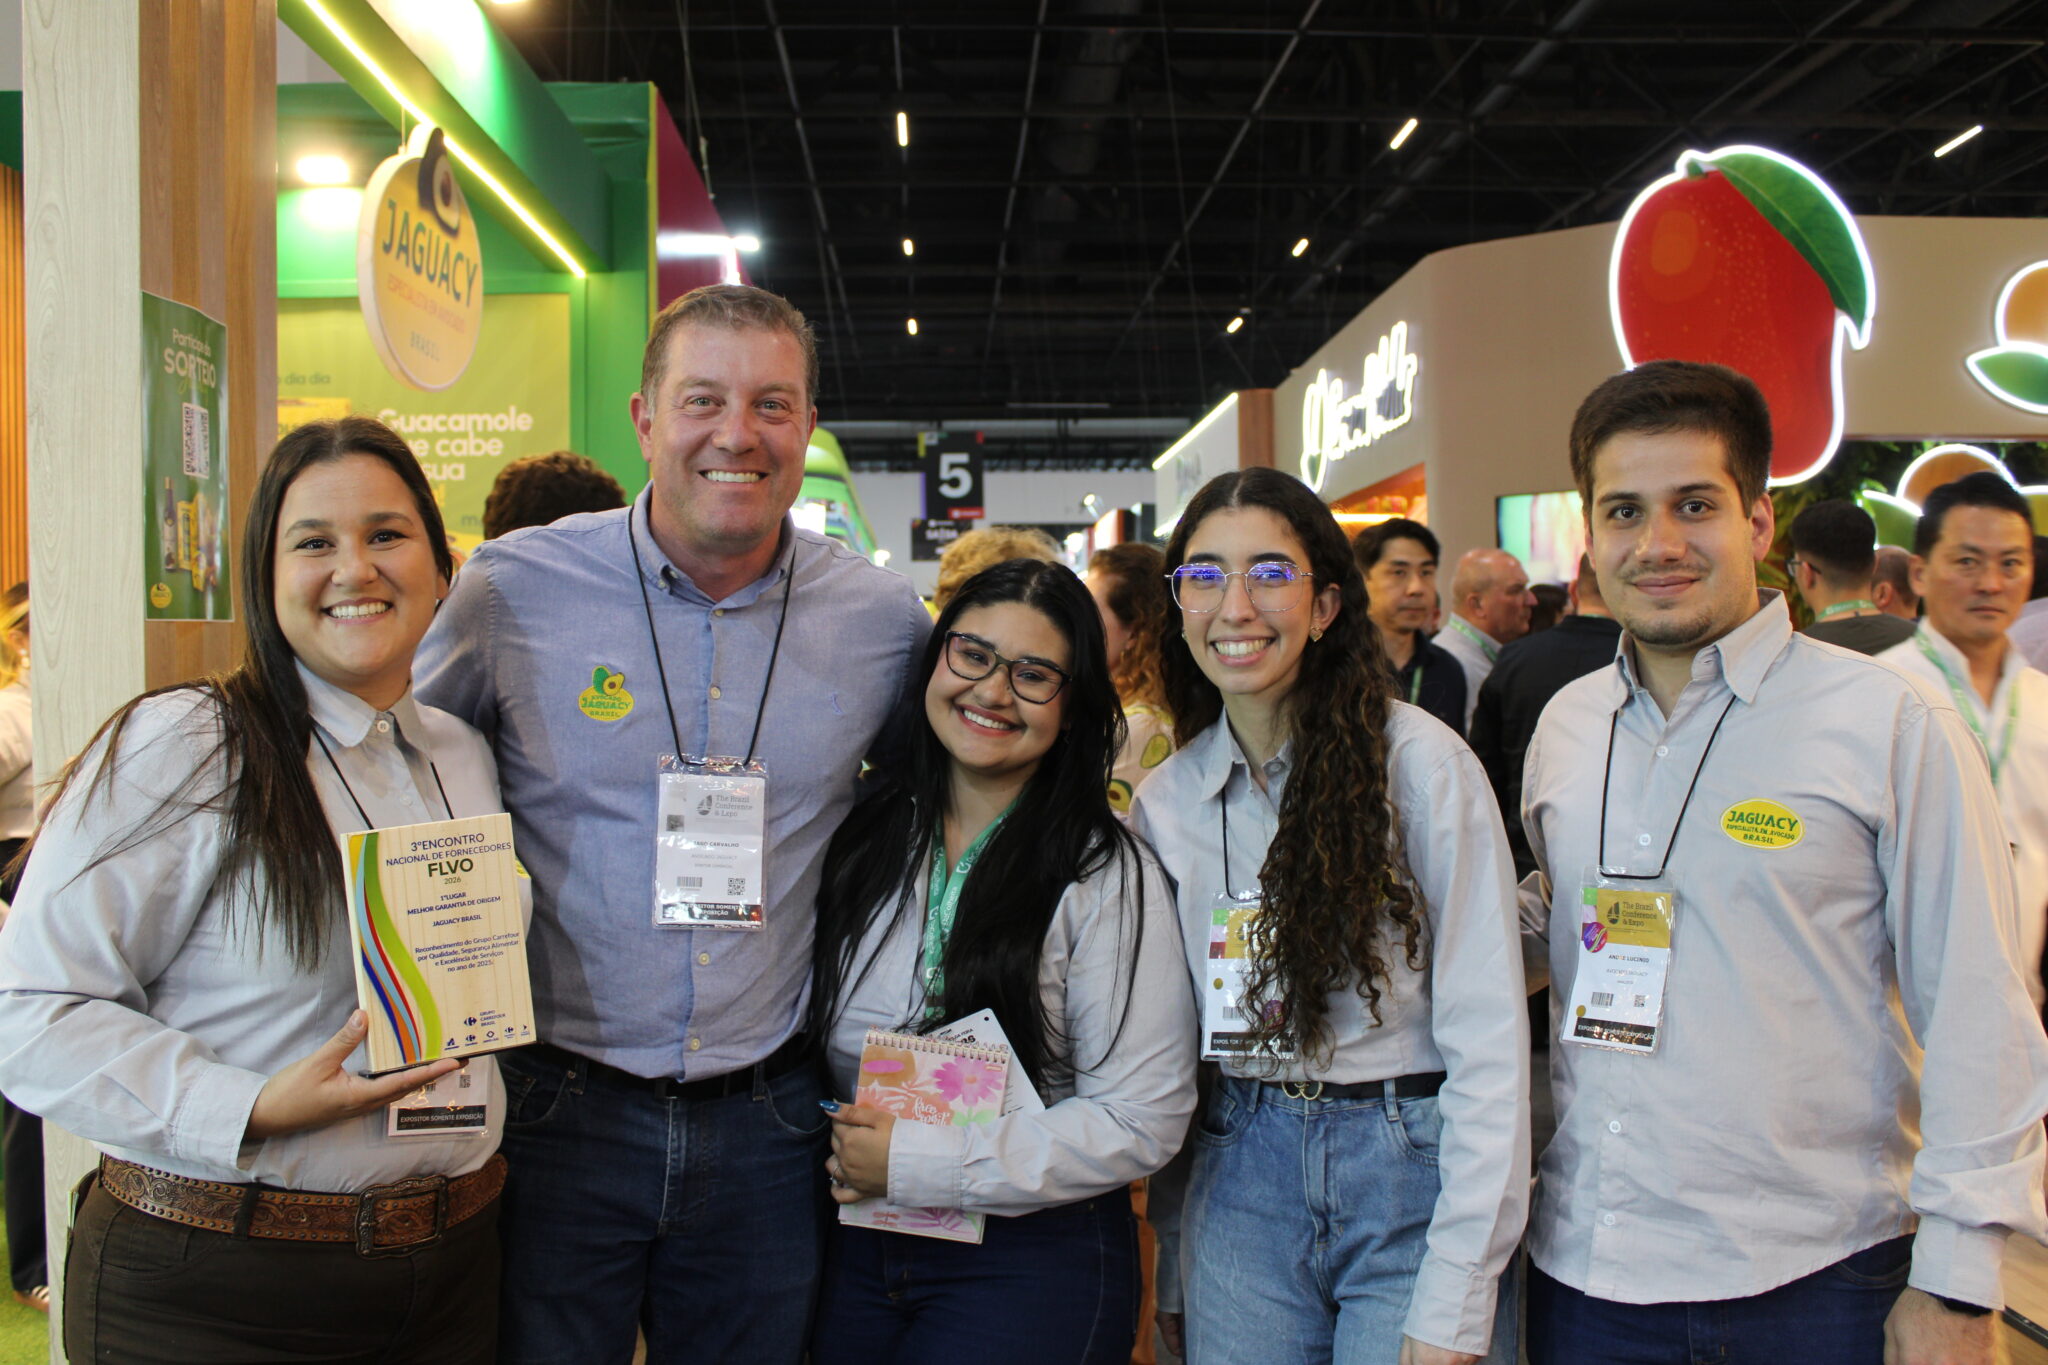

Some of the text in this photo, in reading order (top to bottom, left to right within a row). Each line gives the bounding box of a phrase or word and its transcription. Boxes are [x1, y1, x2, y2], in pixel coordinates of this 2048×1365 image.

[382, 198, 478, 308] JAGUACY
[164, 347, 216, 388] SORTEIO
[380, 406, 533, 433] Guacamole
[435, 432, 504, 457] cabe
[938, 452, 973, 499] 5
[581, 697, 631, 710] JAGUACY
[1728, 810, 1799, 832] JAGUACY
[1743, 834, 1775, 844] BRASIL
[386, 842, 512, 866] NACIONAL DE FORNECEDORES
[427, 858, 474, 877] FLVO
[444, 877, 462, 885] 2026
[407, 906, 435, 915] MELHOR
[435, 901, 467, 911] GARANTIA
[476, 896, 501, 904] ORIGEM
[1622, 901, 1654, 911] The Brazil
[432, 914, 482, 927] JAGUACY BRASIL
[1621, 911, 1658, 920] Conference
[1629, 919, 1645, 927] Expo
[415, 941, 464, 953] Reconhecimento
[473, 936, 492, 945] Grupo
[492, 932, 520, 941] Carrefour
[460, 945, 491, 955] Segurança
[491, 940, 519, 949] Alimentar
[440, 956, 471, 966] Excelência
[479, 950, 504, 959] Serviços
[400, 1114, 430, 1123] EXPOSITOR
[456, 1112, 484, 1120] EXPOSIÇÃO
